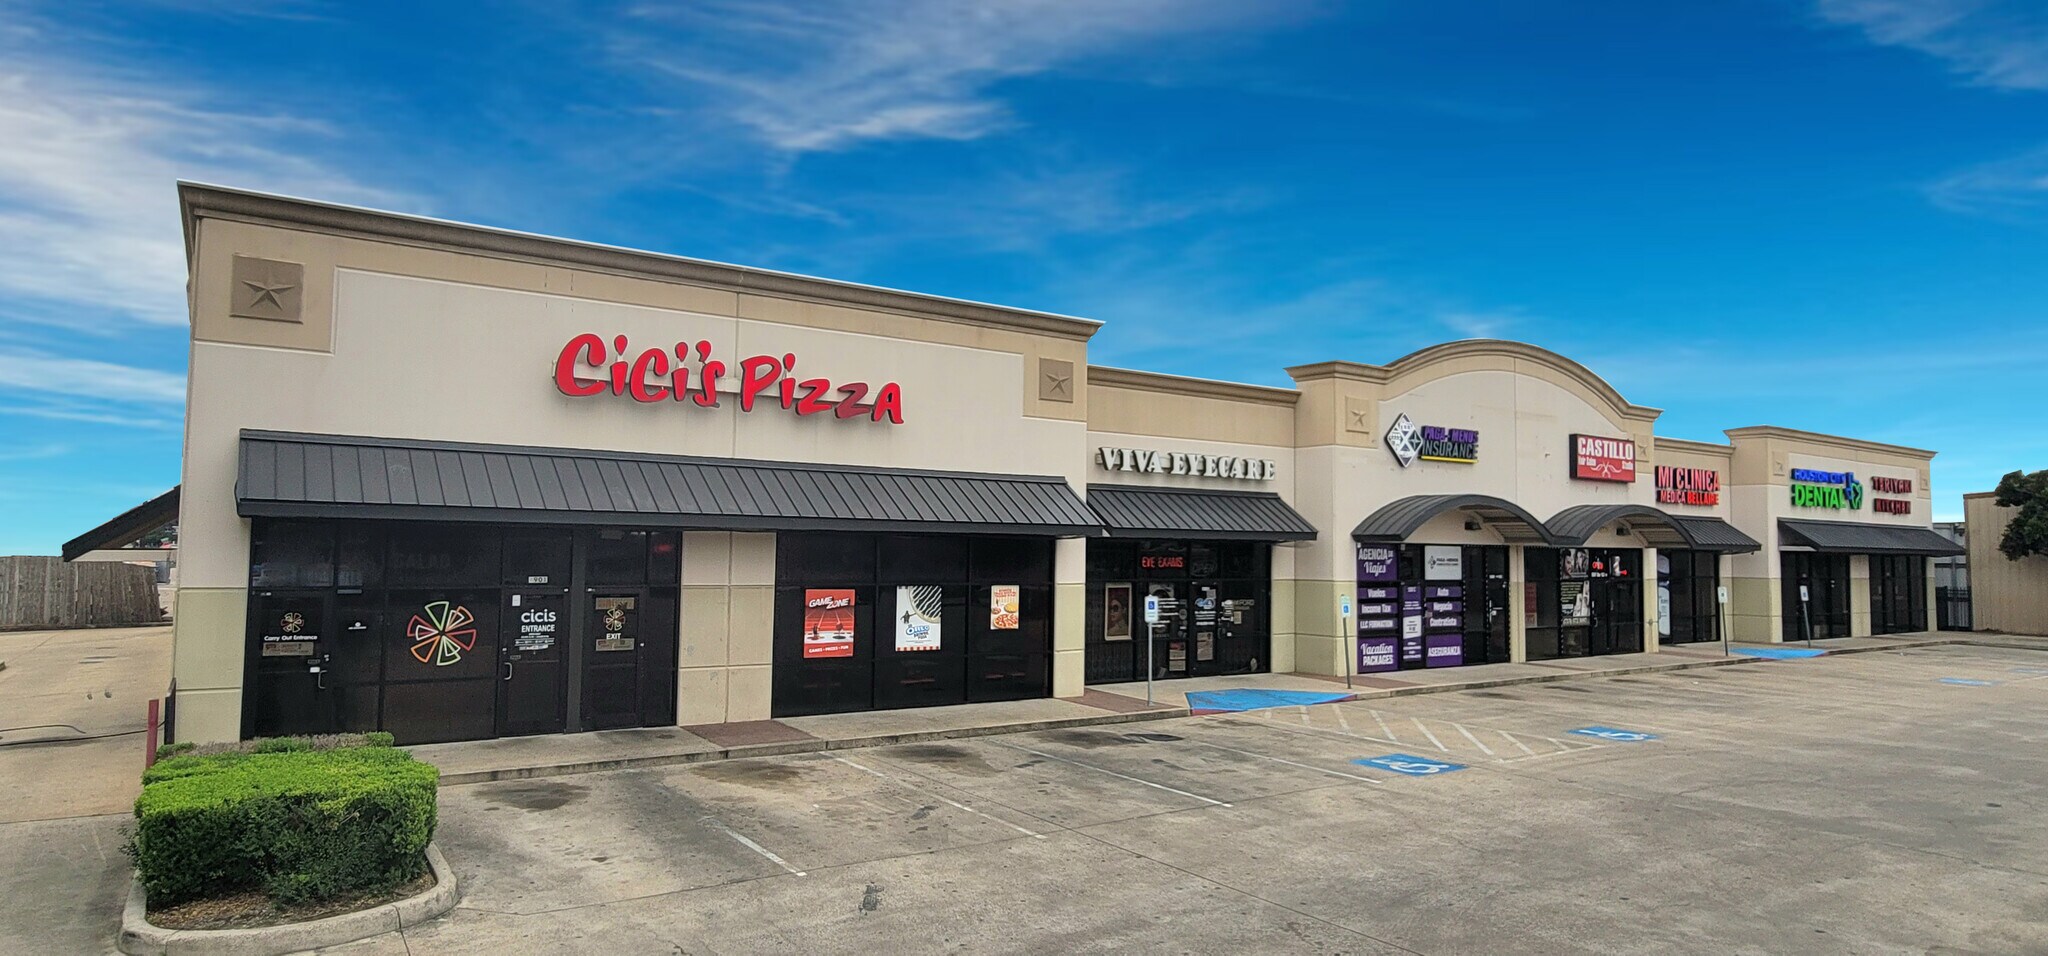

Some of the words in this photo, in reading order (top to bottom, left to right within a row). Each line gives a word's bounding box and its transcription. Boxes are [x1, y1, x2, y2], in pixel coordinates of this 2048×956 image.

[1422, 440, 1479, 458] INSURANCE
[1577, 437, 1634, 460] CASTILLO
[1099, 447, 1163, 474] VIVA
[1168, 452, 1275, 481] EYECARE
[1656, 466, 1674, 488] MI
[1675, 467, 1720, 492] CLINICA
[1793, 469, 1828, 482] HOUSTON
[1829, 473, 1847, 484] CITY
[1872, 477, 1912, 493] TERIYAKI
[1660, 490, 1686, 504] MEDICA
[1687, 491, 1719, 506] BELLAIRE
[1793, 484, 1846, 508] DENTAL
[1875, 499, 1911, 514] KITCHEN
[1359, 548, 1388, 560] AGENCIA
[1142, 556, 1156, 568] EYE
[1158, 556, 1184, 568] EXAMS
[1363, 561, 1387, 577] Viajes
[1367, 588, 1386, 598] Vuelos
[809, 596, 833, 608] GAME
[826, 598, 850, 610] ZONE
[520, 608, 557, 623] cicis
[521, 625, 556, 633] ENTRANCE
[606, 632, 622, 640] EXIT
[1360, 643, 1394, 656] Vacation
[1427, 646, 1461, 658] ASEGURANZA
[1362, 654, 1394, 667] PACKAGES
